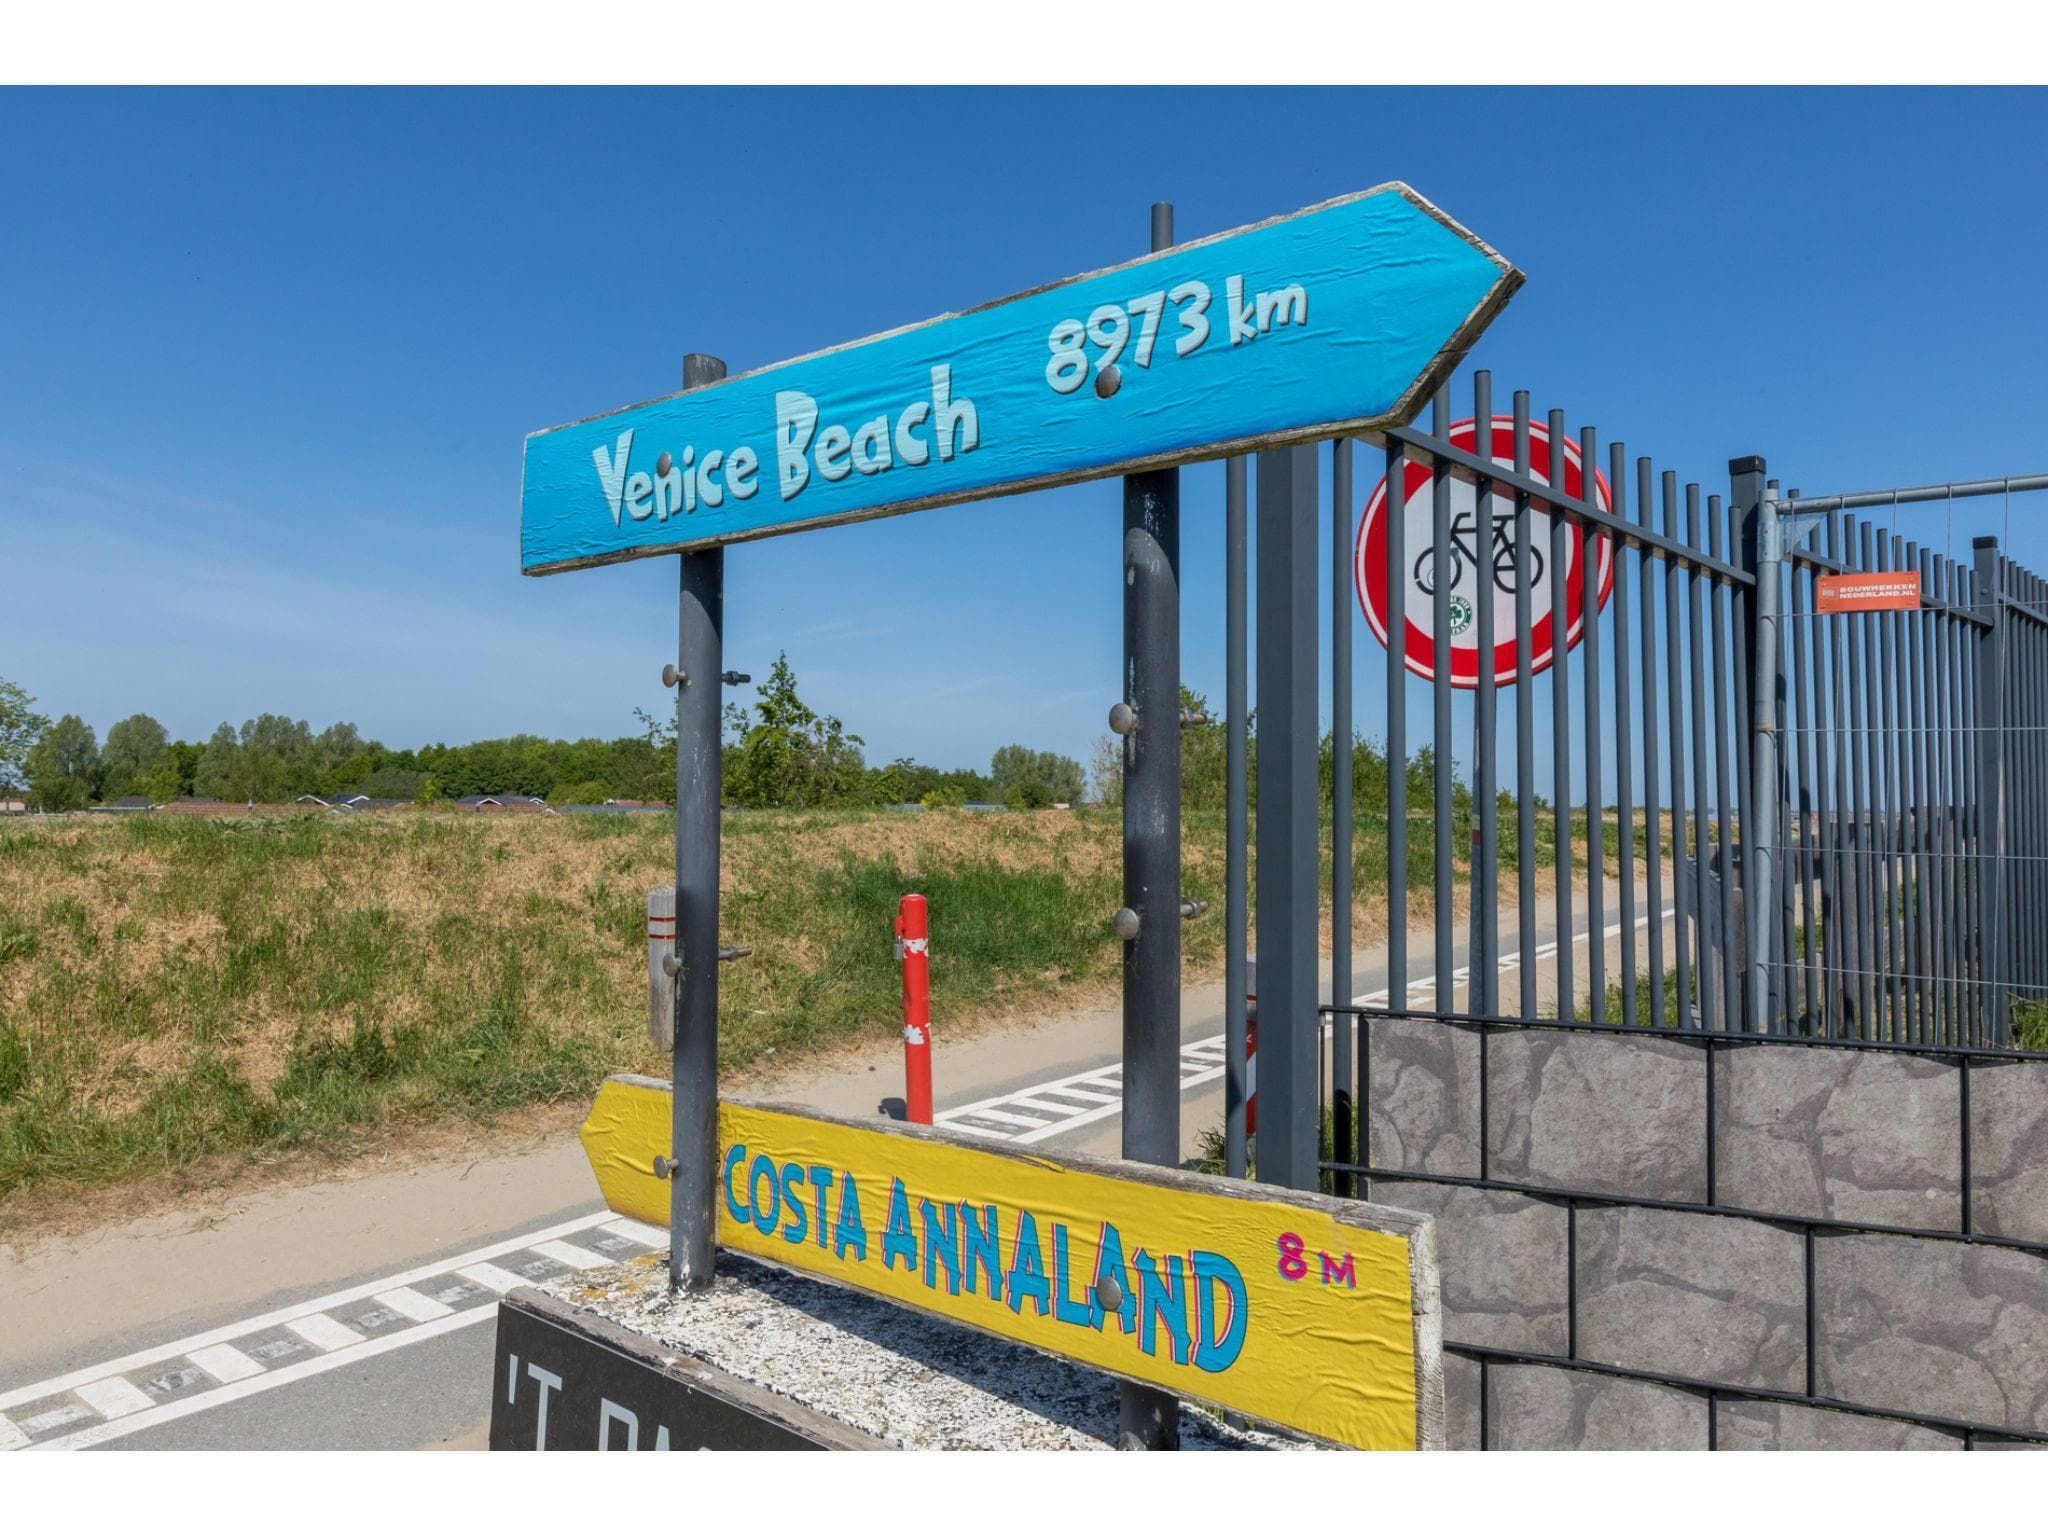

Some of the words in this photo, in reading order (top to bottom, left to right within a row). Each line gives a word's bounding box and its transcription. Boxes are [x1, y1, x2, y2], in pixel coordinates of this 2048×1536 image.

[592, 428, 759, 527] Venice
[775, 363, 980, 500] Beach
[1045, 281, 1211, 394] 8973
[1226, 275, 1307, 345] km
[1839, 583, 1917, 593] BOUWHEKKEN
[1839, 589, 1916, 599] NEDERLAND.NL
[720, 1144, 867, 1261] COSTA
[882, 1174, 1248, 1373] ANNALAND
[1276, 1231, 1307, 1283] 8
[1320, 1250, 1358, 1289] M
